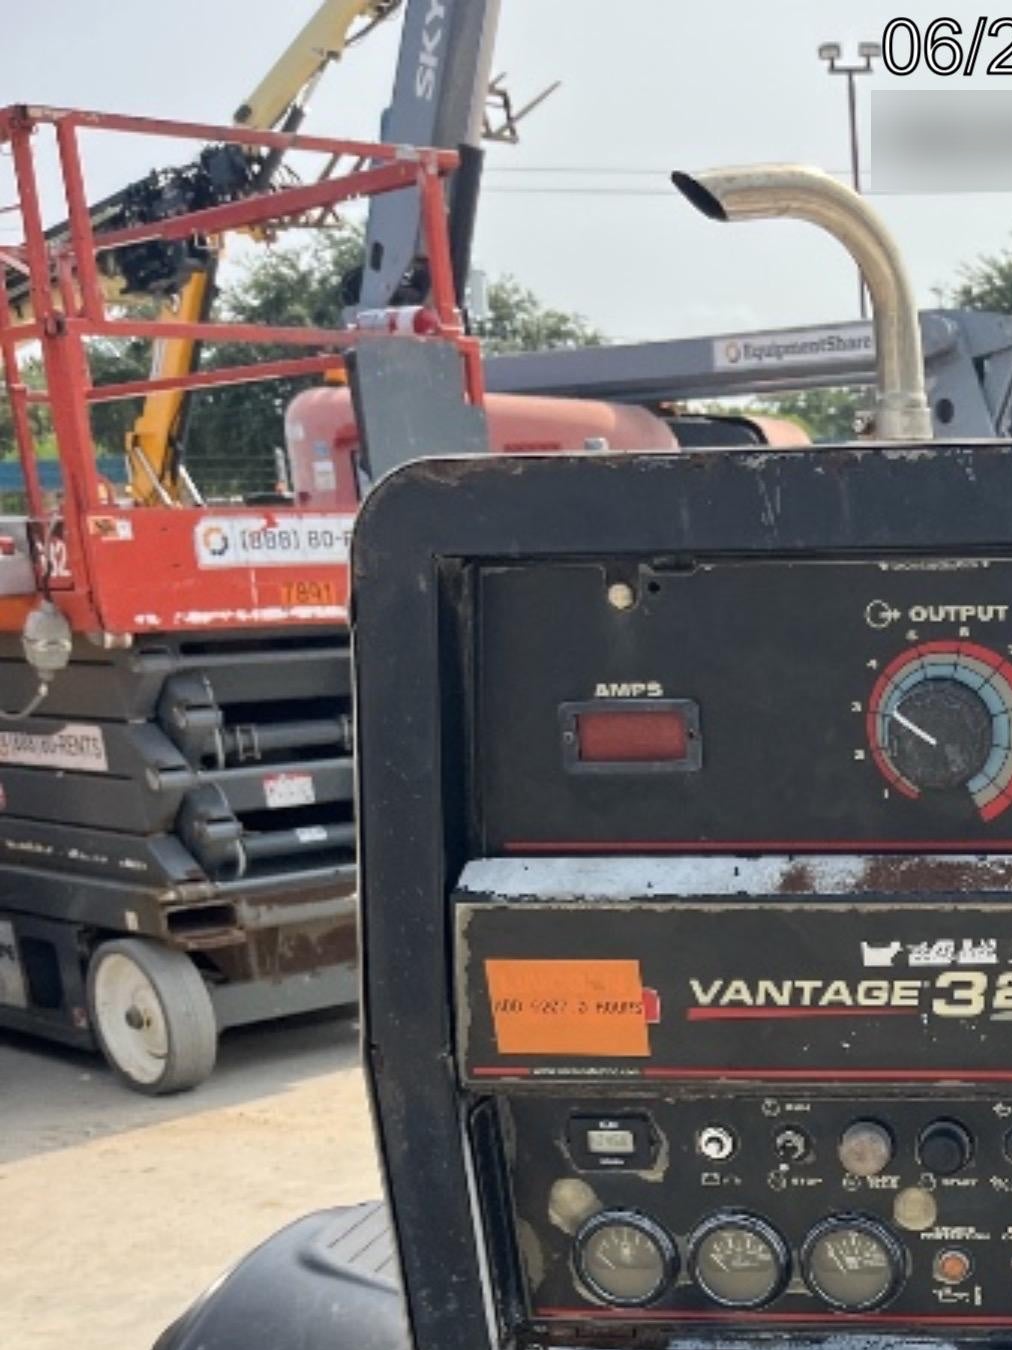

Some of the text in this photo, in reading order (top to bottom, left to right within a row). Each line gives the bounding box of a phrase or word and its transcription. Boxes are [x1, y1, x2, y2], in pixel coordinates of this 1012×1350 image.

[742, 334, 871, 361] EquipmentShare
[908, 604, 1009, 623] OUTPUT
[594, 681, 664, 698] AMPS
[689, 979, 922, 1007] VANTAGE
